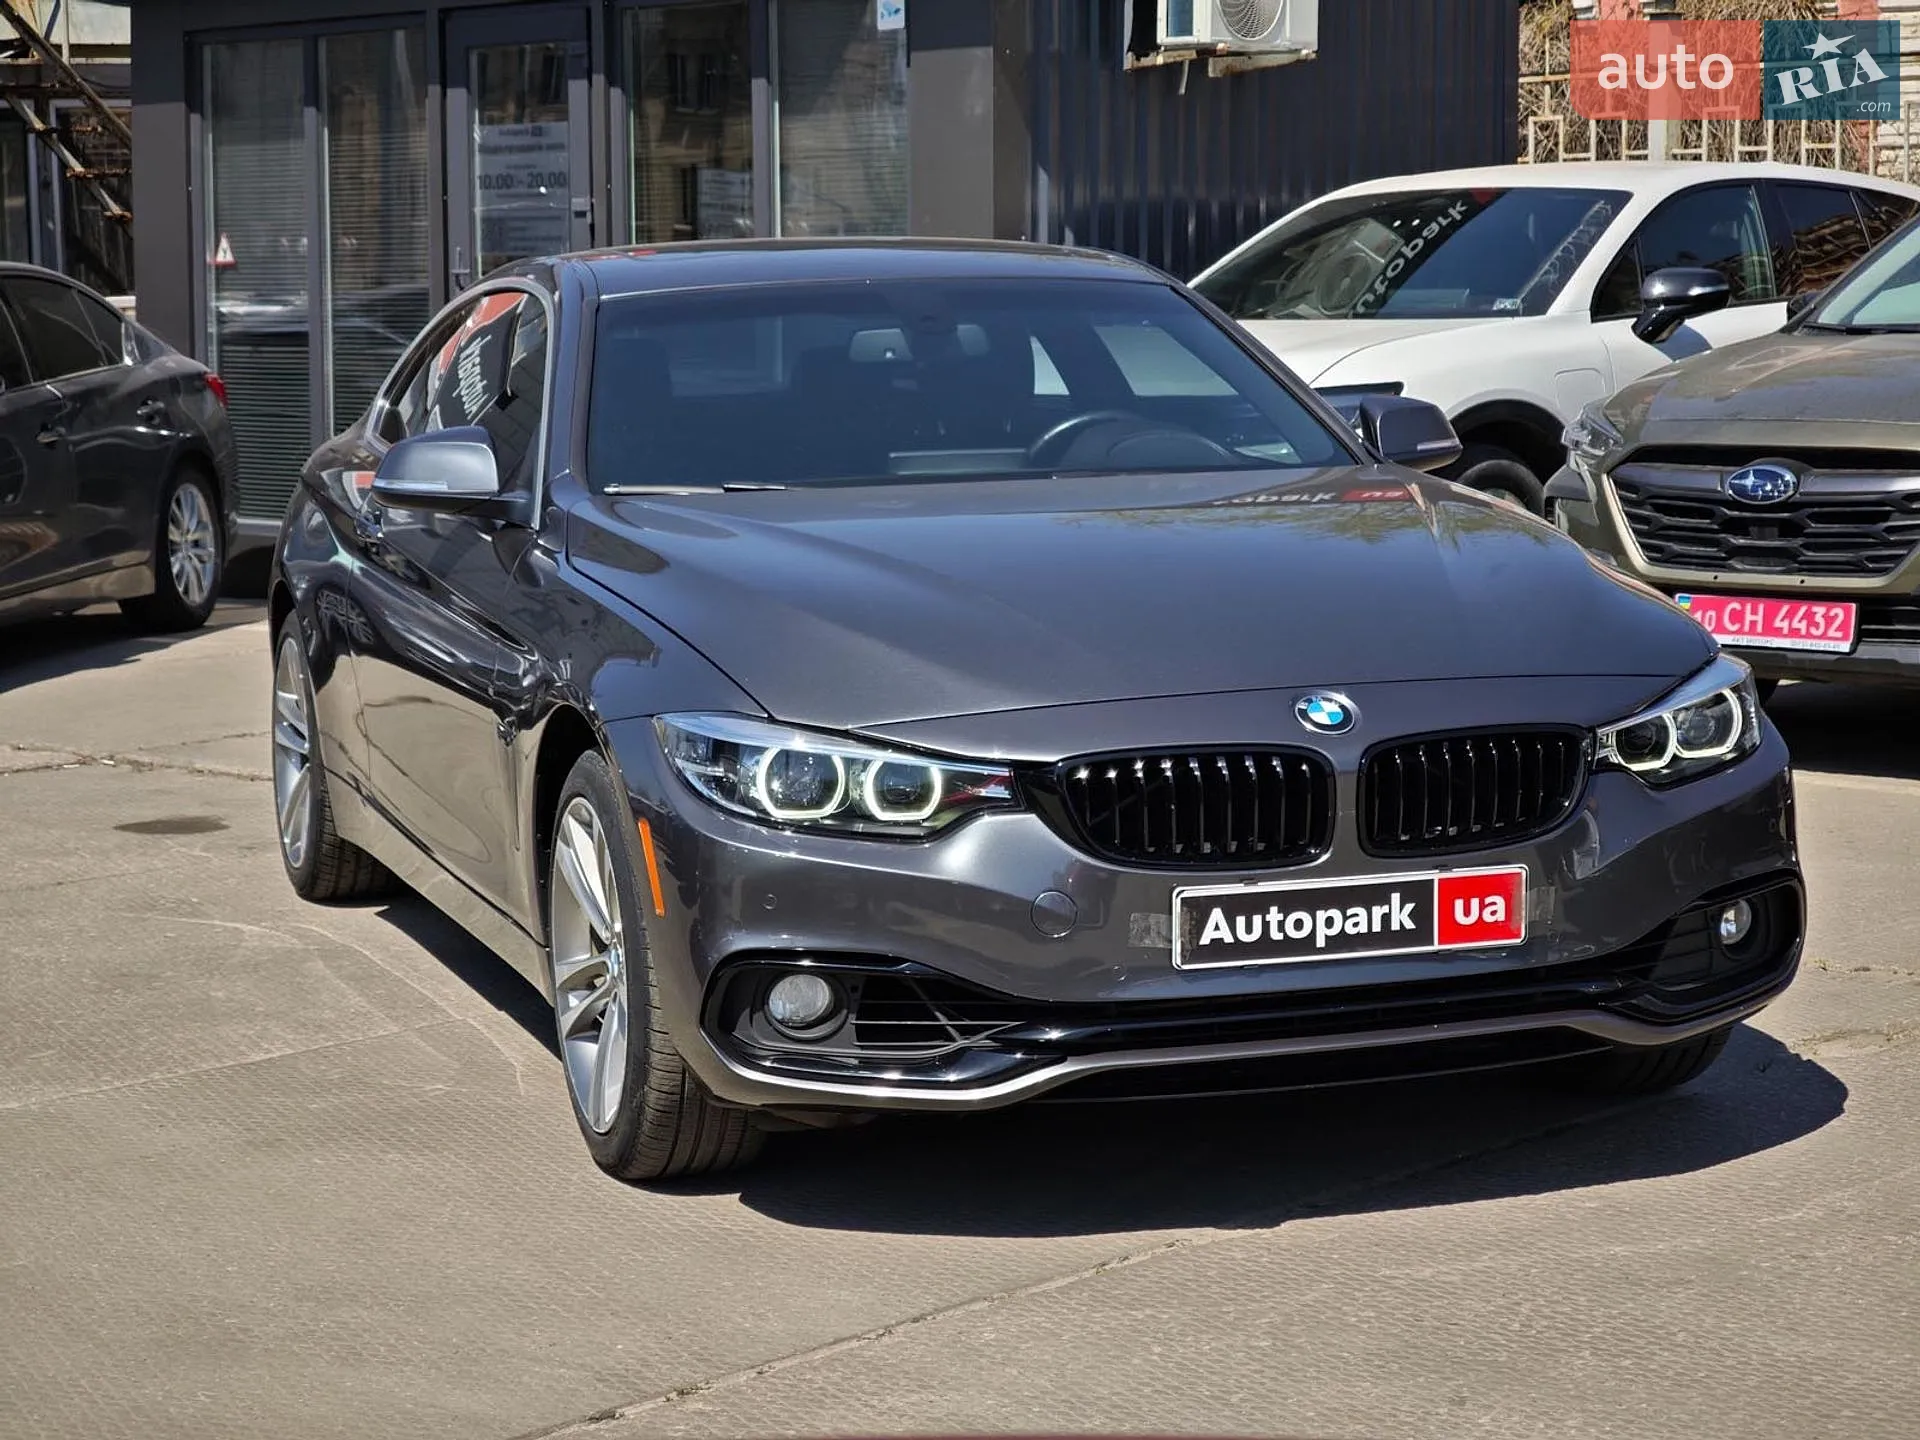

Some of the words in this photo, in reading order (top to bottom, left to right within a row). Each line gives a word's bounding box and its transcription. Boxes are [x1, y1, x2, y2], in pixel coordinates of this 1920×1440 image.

[1723, 602, 1765, 633] CH
[1773, 604, 1845, 638] 4432
[1199, 892, 1417, 948] Autopark
[1453, 893, 1507, 925] ua
